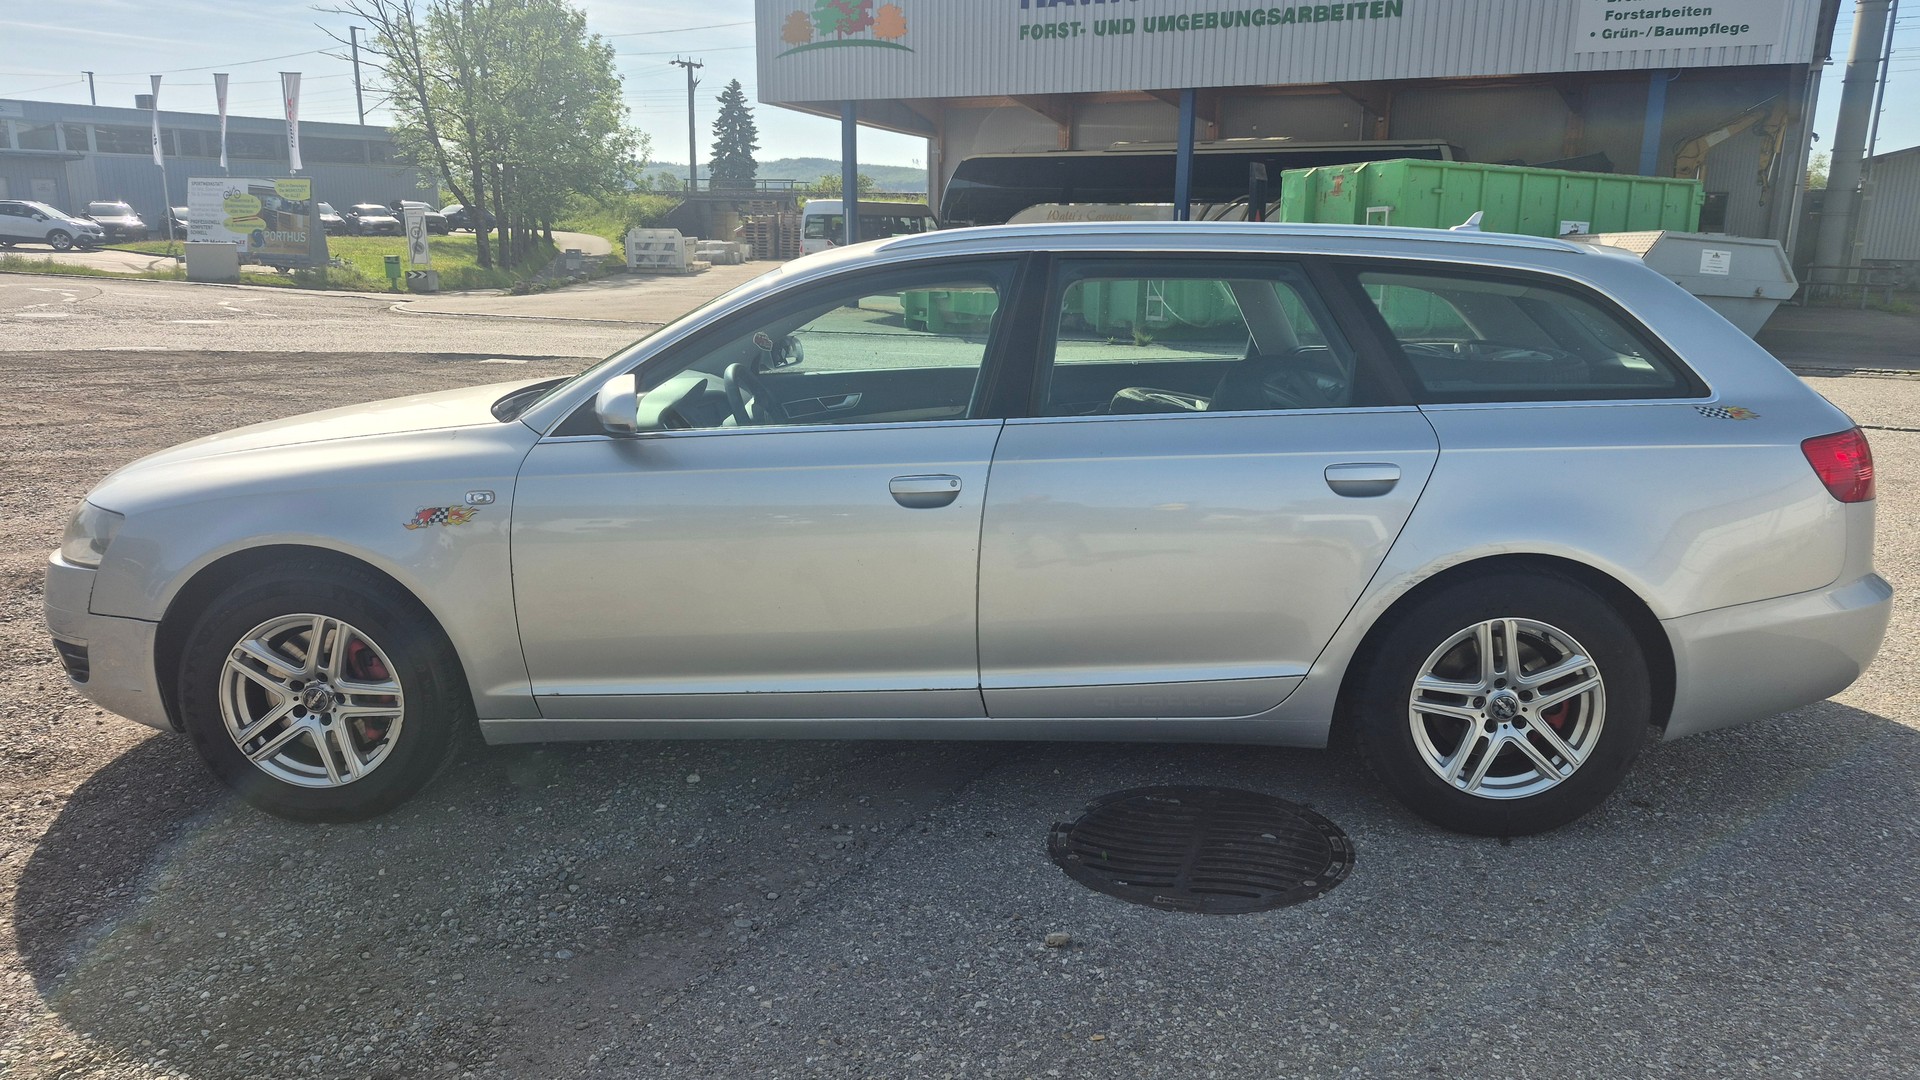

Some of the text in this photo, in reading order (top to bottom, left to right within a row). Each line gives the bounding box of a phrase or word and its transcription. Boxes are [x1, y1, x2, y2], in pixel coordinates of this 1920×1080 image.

[1019, 22, 1086, 40] FORST-
[1094, 18, 1136, 36] UND
[1143, 0, 1403, 33] UMGEBUNGSARBEITEN
[1604, 6, 1712, 21] Forstarbeiten
